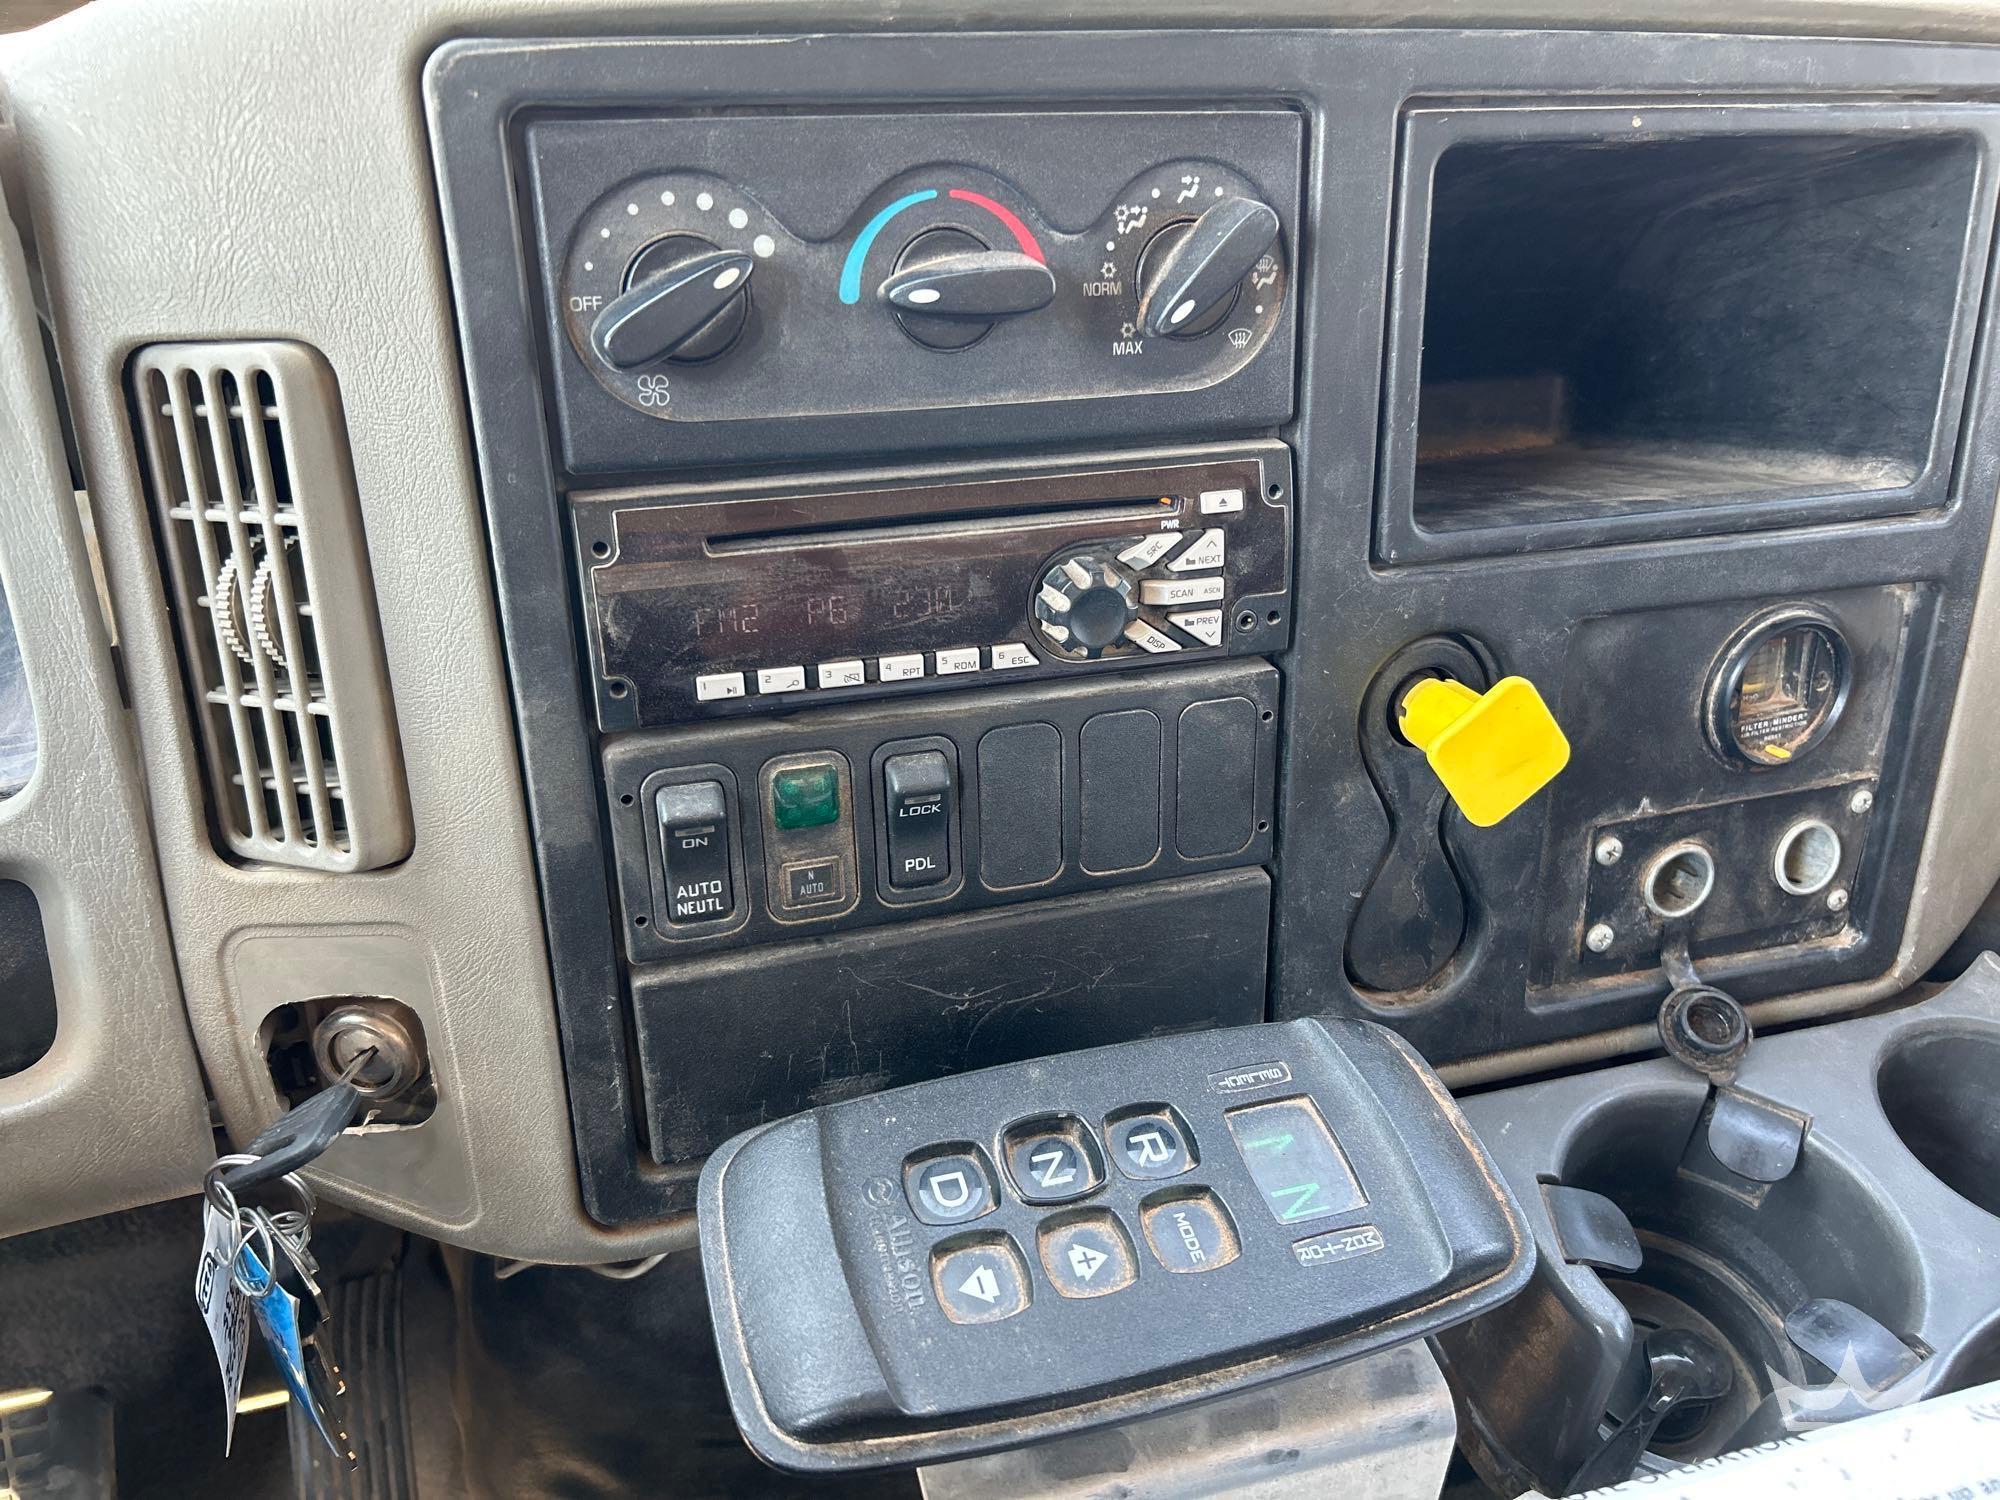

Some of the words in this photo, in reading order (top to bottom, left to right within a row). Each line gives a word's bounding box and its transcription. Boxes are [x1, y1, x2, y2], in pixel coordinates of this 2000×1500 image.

[1083, 281, 1122, 297] NORM
[570, 295, 603, 312] OFF
[1112, 340, 1143, 356] MAX
[1160, 519, 1180, 530] PWR
[1146, 541, 1163, 558] SRC
[1198, 554, 1221, 564] NEXT
[1170, 588, 1194, 599] SCAN
[1196, 615, 1220, 626] PREV
[1146, 635, 1166, 650] DISP
[941, 656, 948, 665] 5
[998, 652, 1005, 660] 6
[1011, 656, 1030, 665] ESC
[885, 663, 892, 672] 4
[902, 667, 921, 677] RPT
[954, 660, 977, 670] RDM
[764, 675, 772, 684] 2
[825, 670, 832, 679] 3
[1741, 720, 1769, 733] FILTER
[899, 803, 942, 817] LOCK
[682, 836, 709, 849] ON
[905, 856, 936, 872] PDL
[807, 871, 815, 881] N
[677, 880, 723, 899] AUTO
[800, 882, 824, 896] AUTO
[677, 897, 724, 916] NEUTL
[1218, 1067, 1283, 1088] SELECT
[1129, 1131, 1168, 1168] R
[1030, 1150, 1074, 1188] N
[929, 1171, 969, 1208] D
[1173, 1212, 1206, 1264] MODE
[1297, 1232, 1380, 1261] MONITOR
